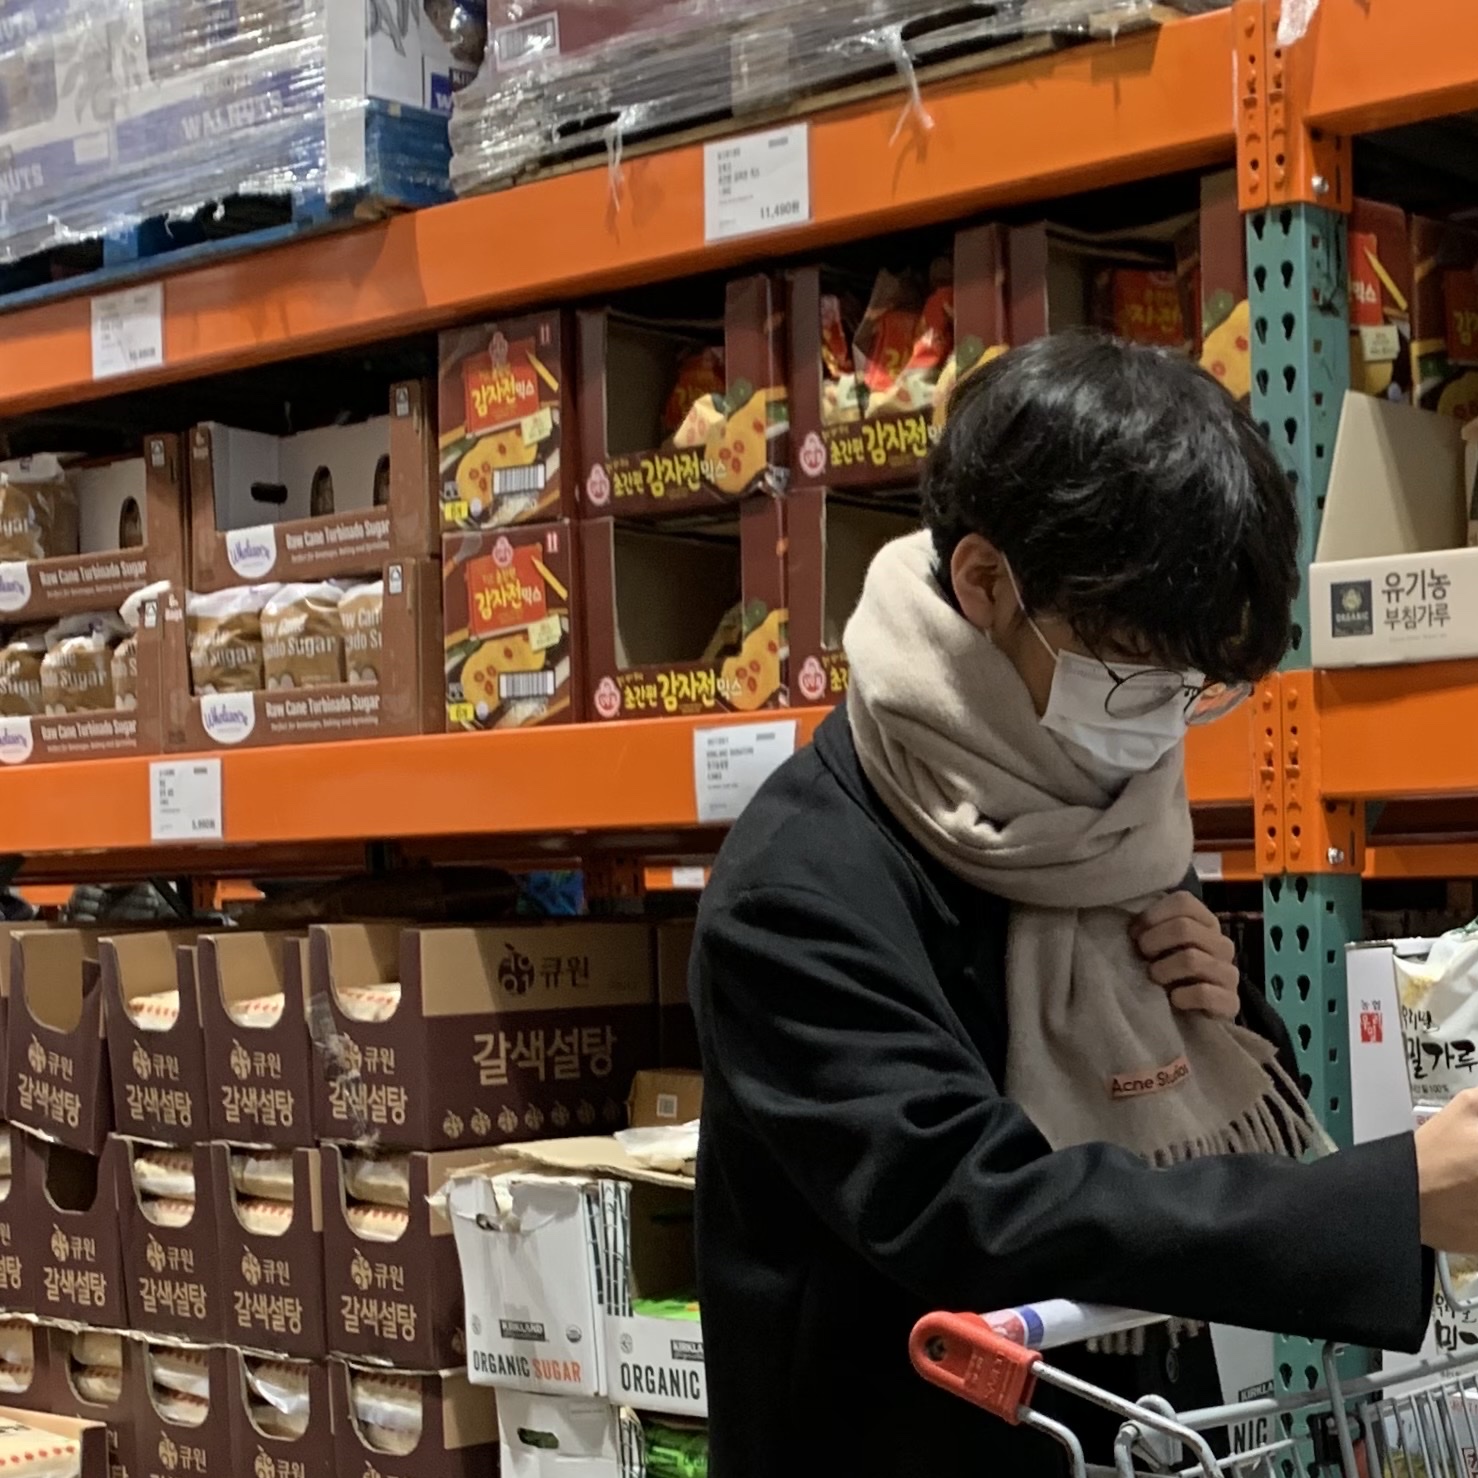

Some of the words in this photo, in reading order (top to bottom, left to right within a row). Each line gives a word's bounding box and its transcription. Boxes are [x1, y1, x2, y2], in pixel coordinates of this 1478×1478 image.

[285, 533, 304, 550] Raw
[304, 530, 324, 546] Cane
[325, 523, 363, 543] Turbinado
[364, 519, 389, 539] Sugar
[39, 570, 58, 587] Raw
[59, 569, 79, 583] Cane
[80, 564, 120, 582] Turbinado
[120, 560, 147, 578] Sugar
[1381, 568, 1451, 601] 유기농
[1383, 603, 1451, 632] 부침가루
[266, 702, 284, 718] Raw
[285, 701, 308, 715] Cane
[309, 696, 351, 715] Turbinado
[352, 694, 380, 712] Sugar
[41, 725, 58, 741] Raw
[58, 724, 80, 739] Cane
[115, 719, 137, 736] Sugar
[539, 956, 590, 989] 큐원
[47, 1051, 73, 1081] 큐원
[153, 1053, 179, 1081] 큐원
[253, 1050, 281, 1079] 큐원
[365, 1046, 395, 1076] 큐원
[473, 1023, 618, 1088] 갈색설탕
[1406, 1038, 1478, 1079] 밀가루
[1112, 1078, 1154, 1092] Acne
[17, 1073, 82, 1129] 갈색설탕
[126, 1083, 193, 1128] 갈색설탕
[221, 1084, 294, 1128] 갈색설탕
[329, 1079, 408, 1126] 갈색설탕
[70, 1235, 96, 1262] 큐원
[167, 1245, 194, 1273] 큐원
[43, 1265, 107, 1307] 갈색설탕
[263, 1259, 290, 1287] 큐원
[374, 1262, 405, 1292] 큐원
[139, 1277, 207, 1320] 갈색설탕
[234, 1290, 303, 1335] 갈색설탕
[340, 1295, 417, 1342] 갈색설탕
[473, 1349, 530, 1378] ORGANIC
[532, 1357, 581, 1383] SUGAR
[620, 1362, 700, 1401] ORGANIC
[179, 1446, 208, 1475] 큐원
